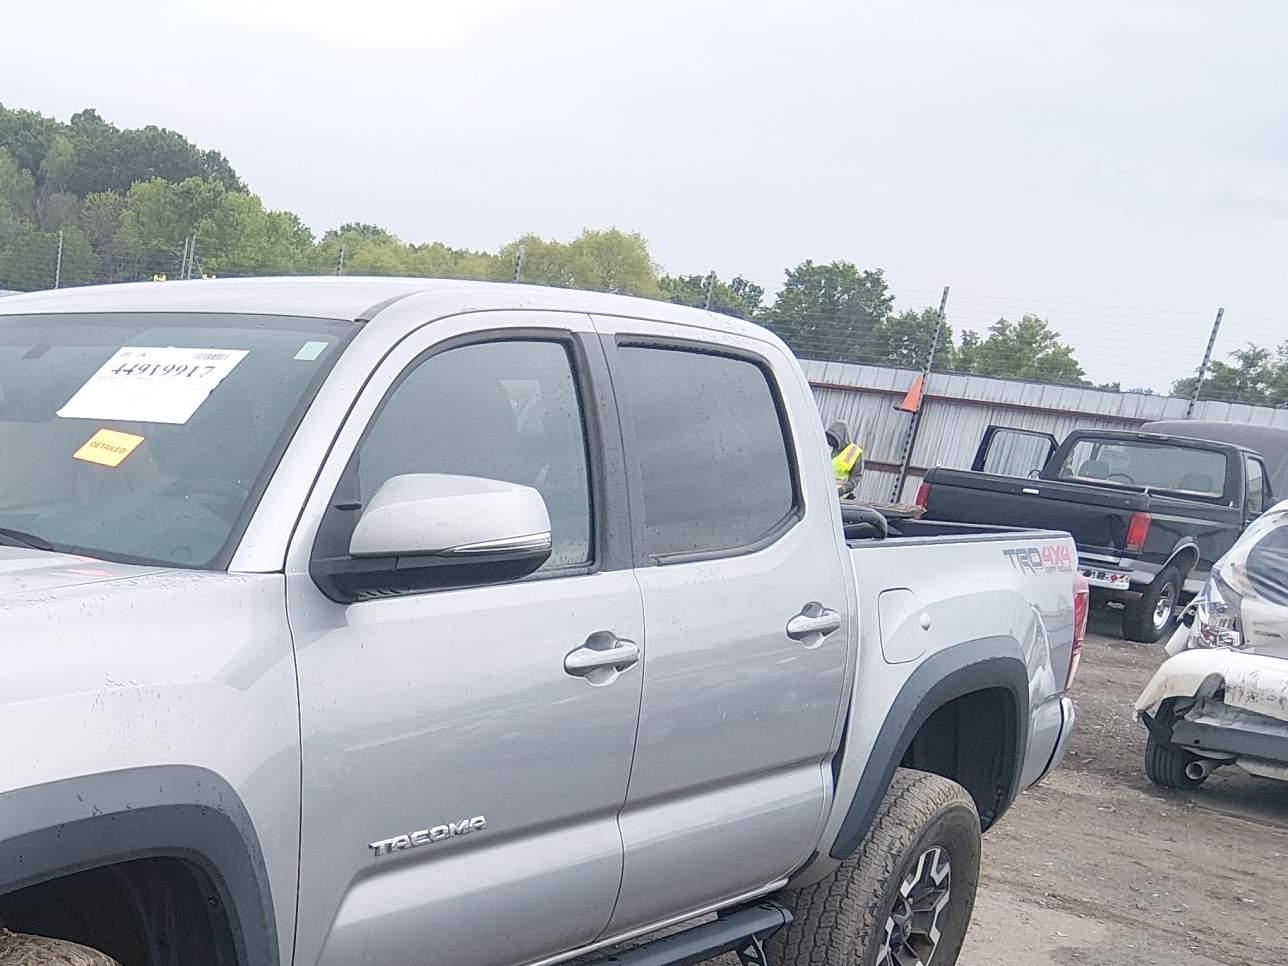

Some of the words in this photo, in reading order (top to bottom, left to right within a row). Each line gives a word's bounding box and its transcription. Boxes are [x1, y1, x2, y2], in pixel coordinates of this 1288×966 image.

[111, 363, 217, 379] 44919917
[1002, 547, 1043, 575] TRD
[367, 815, 488, 857] TACOMA
